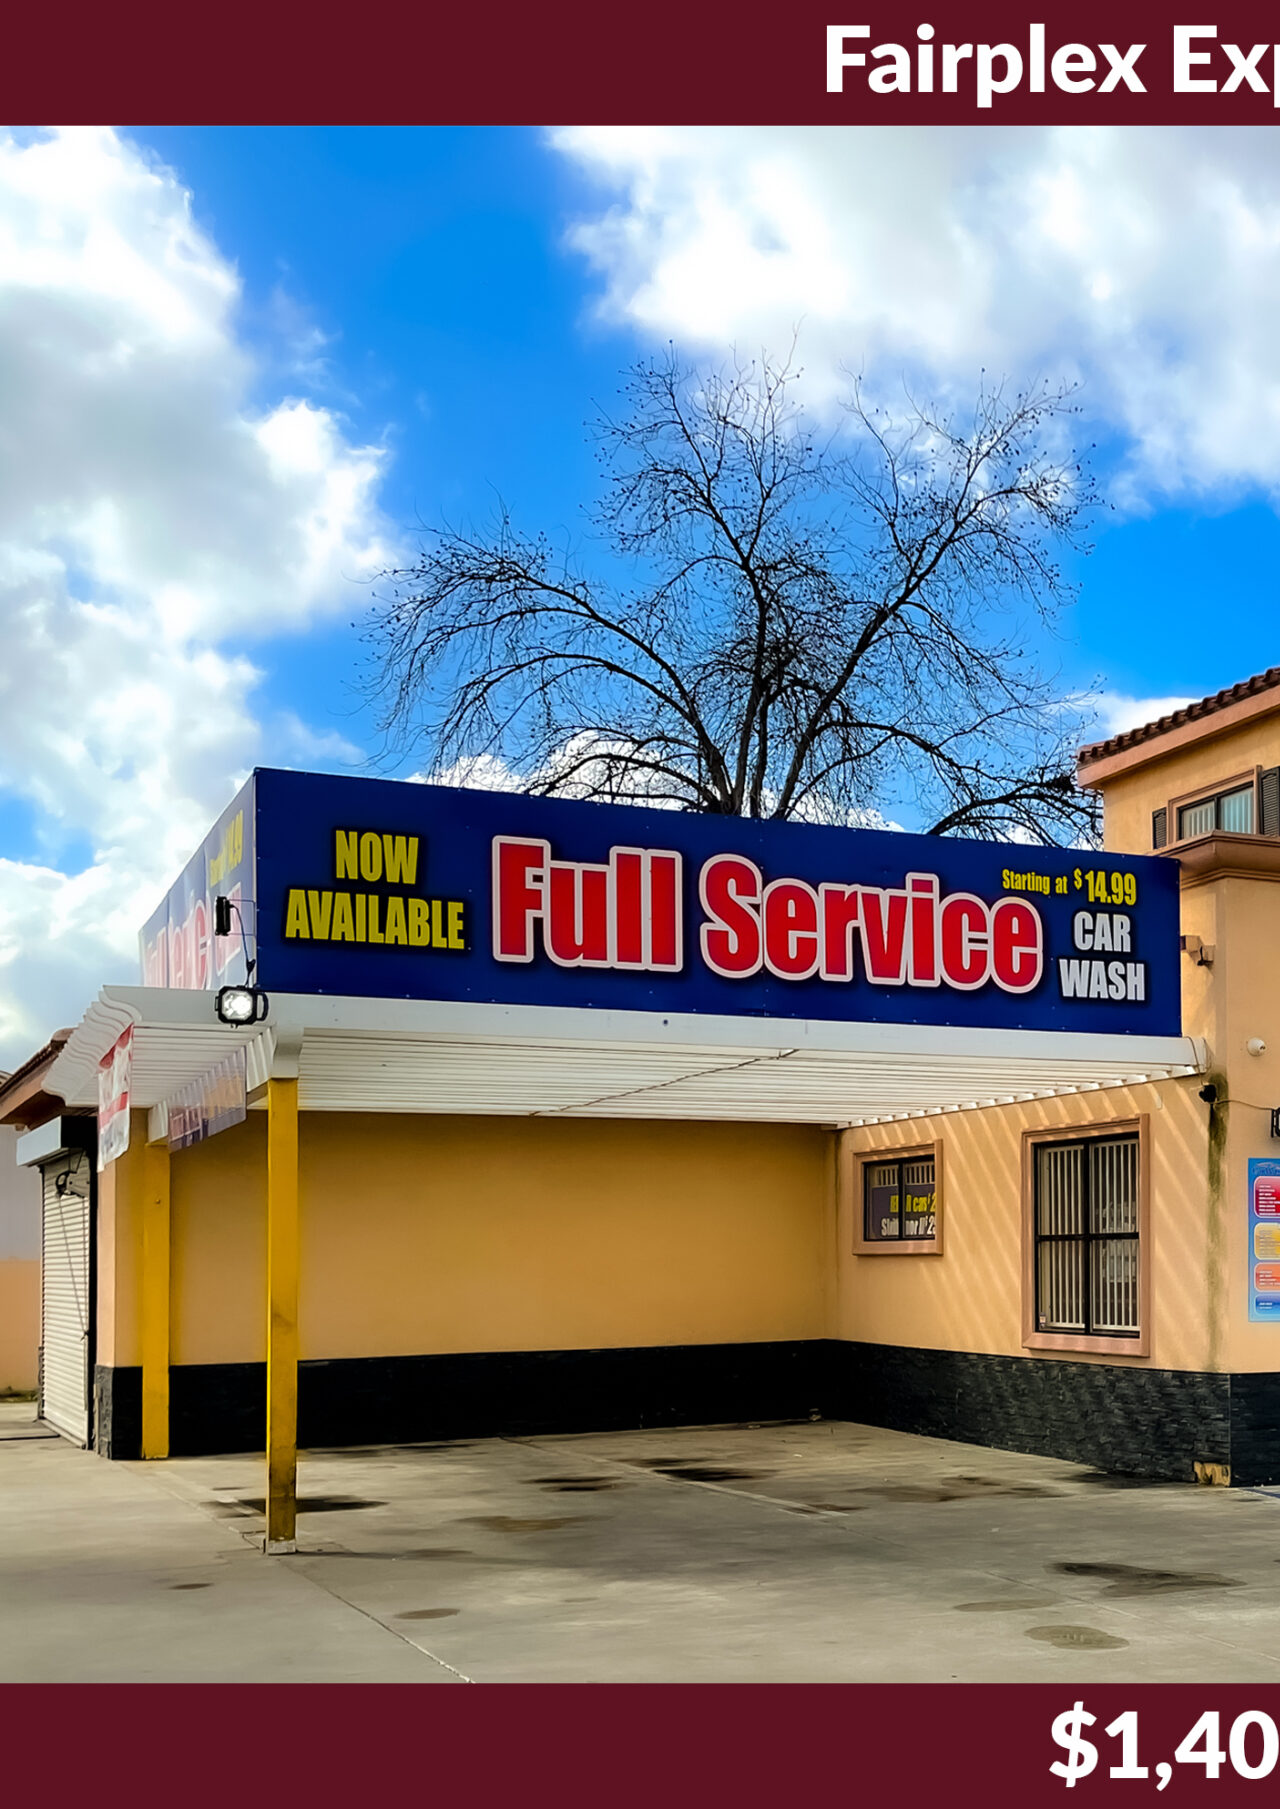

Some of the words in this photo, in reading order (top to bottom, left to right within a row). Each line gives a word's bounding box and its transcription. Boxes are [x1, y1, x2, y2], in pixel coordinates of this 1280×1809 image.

[334, 829, 420, 885] NOW
[1001, 868, 1051, 896] Starting
[1054, 875, 1068, 895] at
[285, 888, 466, 950] AVAILABLE
[491, 834, 684, 973] Full
[699, 853, 1044, 994] Service
[1073, 911, 1132, 953] CAR
[1059, 958, 1146, 1002] WASH
